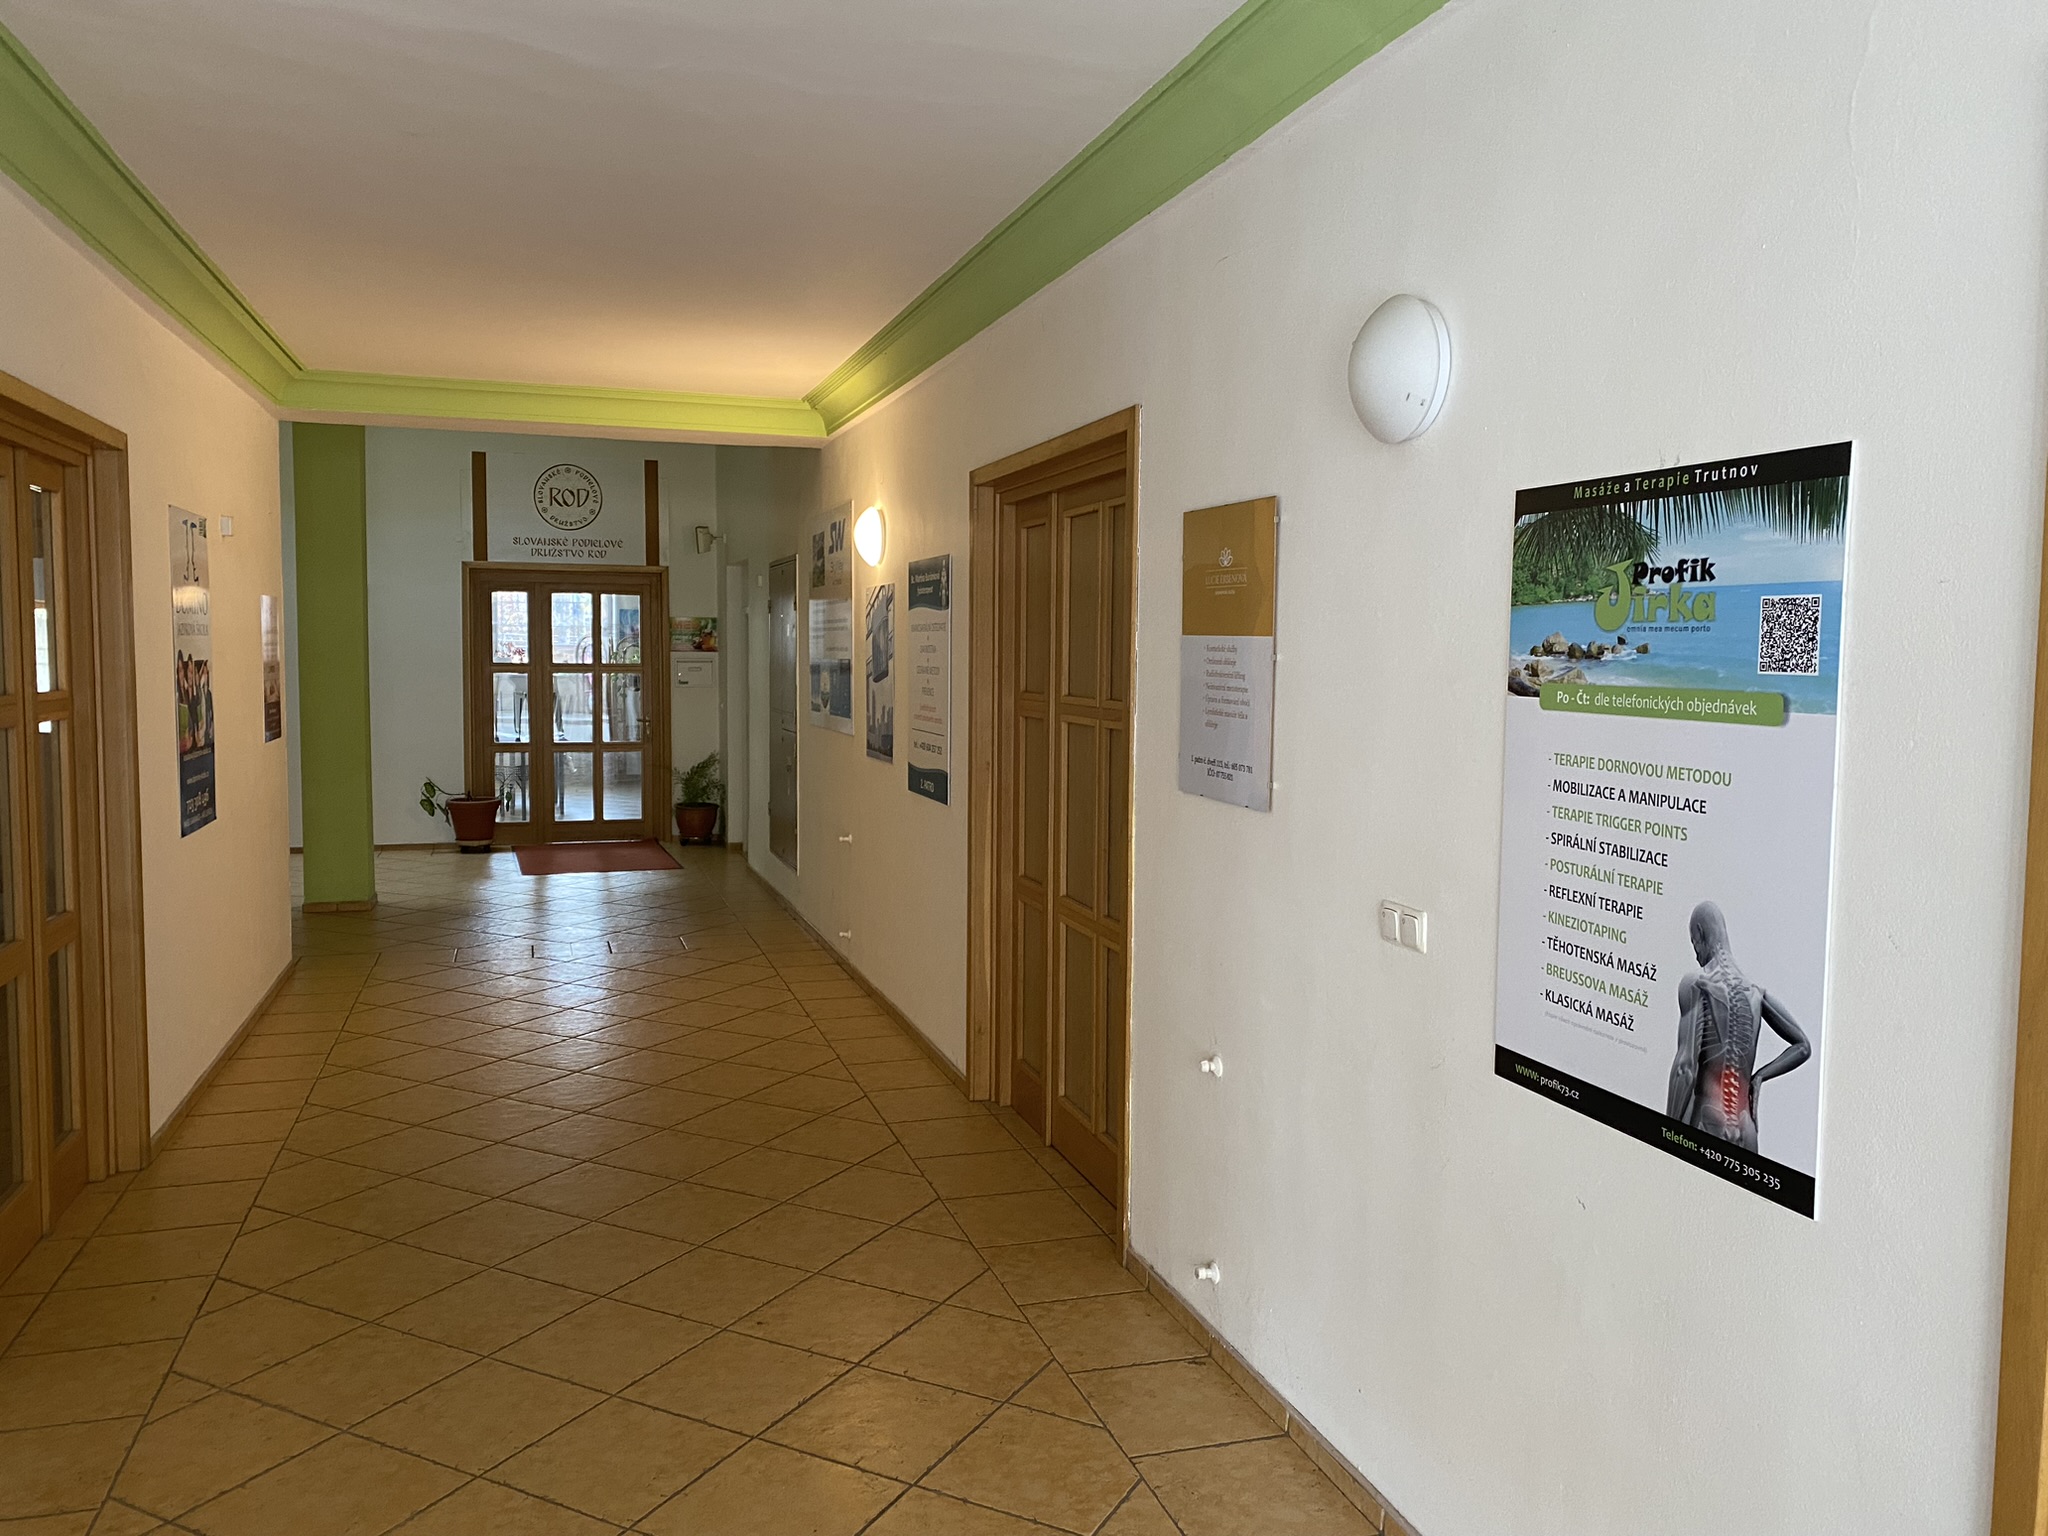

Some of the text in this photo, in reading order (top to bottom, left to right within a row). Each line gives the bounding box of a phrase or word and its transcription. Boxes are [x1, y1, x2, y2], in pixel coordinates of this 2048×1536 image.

[549, 487, 590, 508] ROD
[1573, 462, 1759, 500] Masáže a Terapie Trutnov
[1593, 558, 1717, 633] Jirka
[1648, 625, 1663, 633] mea
[1664, 625, 1690, 634] mecum
[1690, 624, 1712, 634] porto
[1557, 691, 1569, 703] Po
[1577, 690, 1590, 706] Čt:
[1594, 692, 1610, 707] dle
[1612, 693, 1684, 714] telefonických
[1687, 697, 1758, 717] objednávek
[1554, 752, 1732, 787] TERAPIE DORNOVOU METODOU
[1553, 779, 1707, 814] MOBILIZACE A MANIPULACE
[1552, 805, 1688, 841] TERAPIE TRIGGER POINTS
[1551, 832, 1668, 867] SPIRÁLNÍ STABILIZACE
[1550, 858, 1664, 896] POSTURÁLNÍ TERAPIE
[1549, 884, 1643, 920] REFLEXNÍ TERAPIE
[1548, 910, 1627, 944] KINEZIOTAPING
[1547, 936, 1657, 982] TĚHOTENSKÁ MASÁŽ
[1546, 963, 1649, 1008] BREUSSOVA MASÁŽ
[1545, 989, 1593, 1018] KLASICKÁ
[1595, 1006, 1634, 1032] MASÁŽ
[1540, 1075, 1579, 1100] profik73.cz
[1661, 1126, 1782, 1191] Telefon: +420 775 305 235
